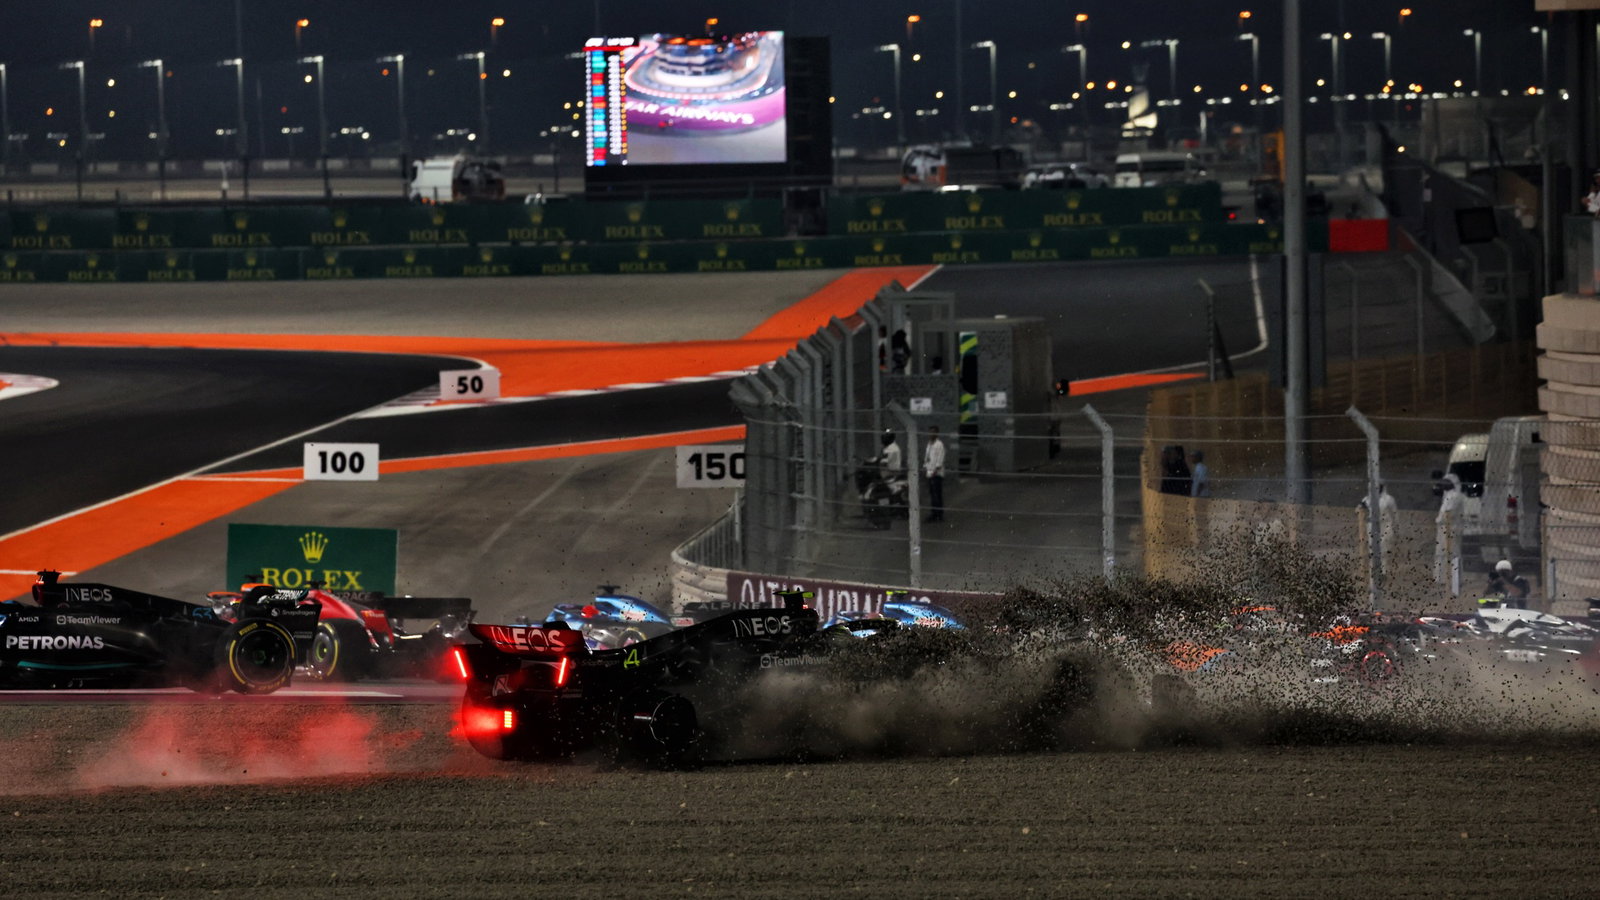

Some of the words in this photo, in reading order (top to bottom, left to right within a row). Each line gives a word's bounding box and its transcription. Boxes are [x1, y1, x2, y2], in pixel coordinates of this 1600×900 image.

[1043, 213, 1102, 226] ROLEX
[1143, 210, 1201, 222] ROLEX
[848, 220, 906, 232] ROLEX
[945, 216, 1004, 229] ROLEX
[409, 229, 467, 241] ROLEX
[508, 228, 566, 240] ROLEX
[605, 225, 664, 238] ROLEX
[703, 224, 762, 236] ROLEX
[12, 235, 72, 248] ROLEX
[113, 235, 172, 247] ROLEX
[212, 233, 271, 245] ROLEX
[311, 232, 370, 244] ROLEX
[1011, 249, 1059, 261] ROLEX
[1090, 247, 1138, 258] ROLEX
[1169, 245, 1217, 255] ROLEX
[776, 257, 823, 268] ROLEX
[855, 254, 902, 265] ROLEX
[932, 252, 980, 262] ROLEX
[385, 266, 433, 276] ROLEX
[463, 265, 510, 275] ROLEX
[542, 263, 590, 273] ROLEX
[619, 262, 667, 272] ROLEX
[698, 260, 745, 271] ROLEX
[68, 270, 117, 280] ROLEX
[147, 270, 195, 280] ROLEX
[227, 269, 275, 279] ROLEX
[306, 267, 354, 278] ROLEX
[457, 375, 483, 394] 50
[318, 451, 365, 473] 100
[688, 453, 746, 480] 150
[261, 568, 364, 591] ROLEX
[65, 588, 112, 601] INEOS
[698, 602, 761, 610] ALPINE
[66, 615, 120, 624] TeamViewer
[731, 615, 792, 638] INEOS
[6, 635, 105, 649] PETRONAS
[489, 626, 566, 652] INEOS
